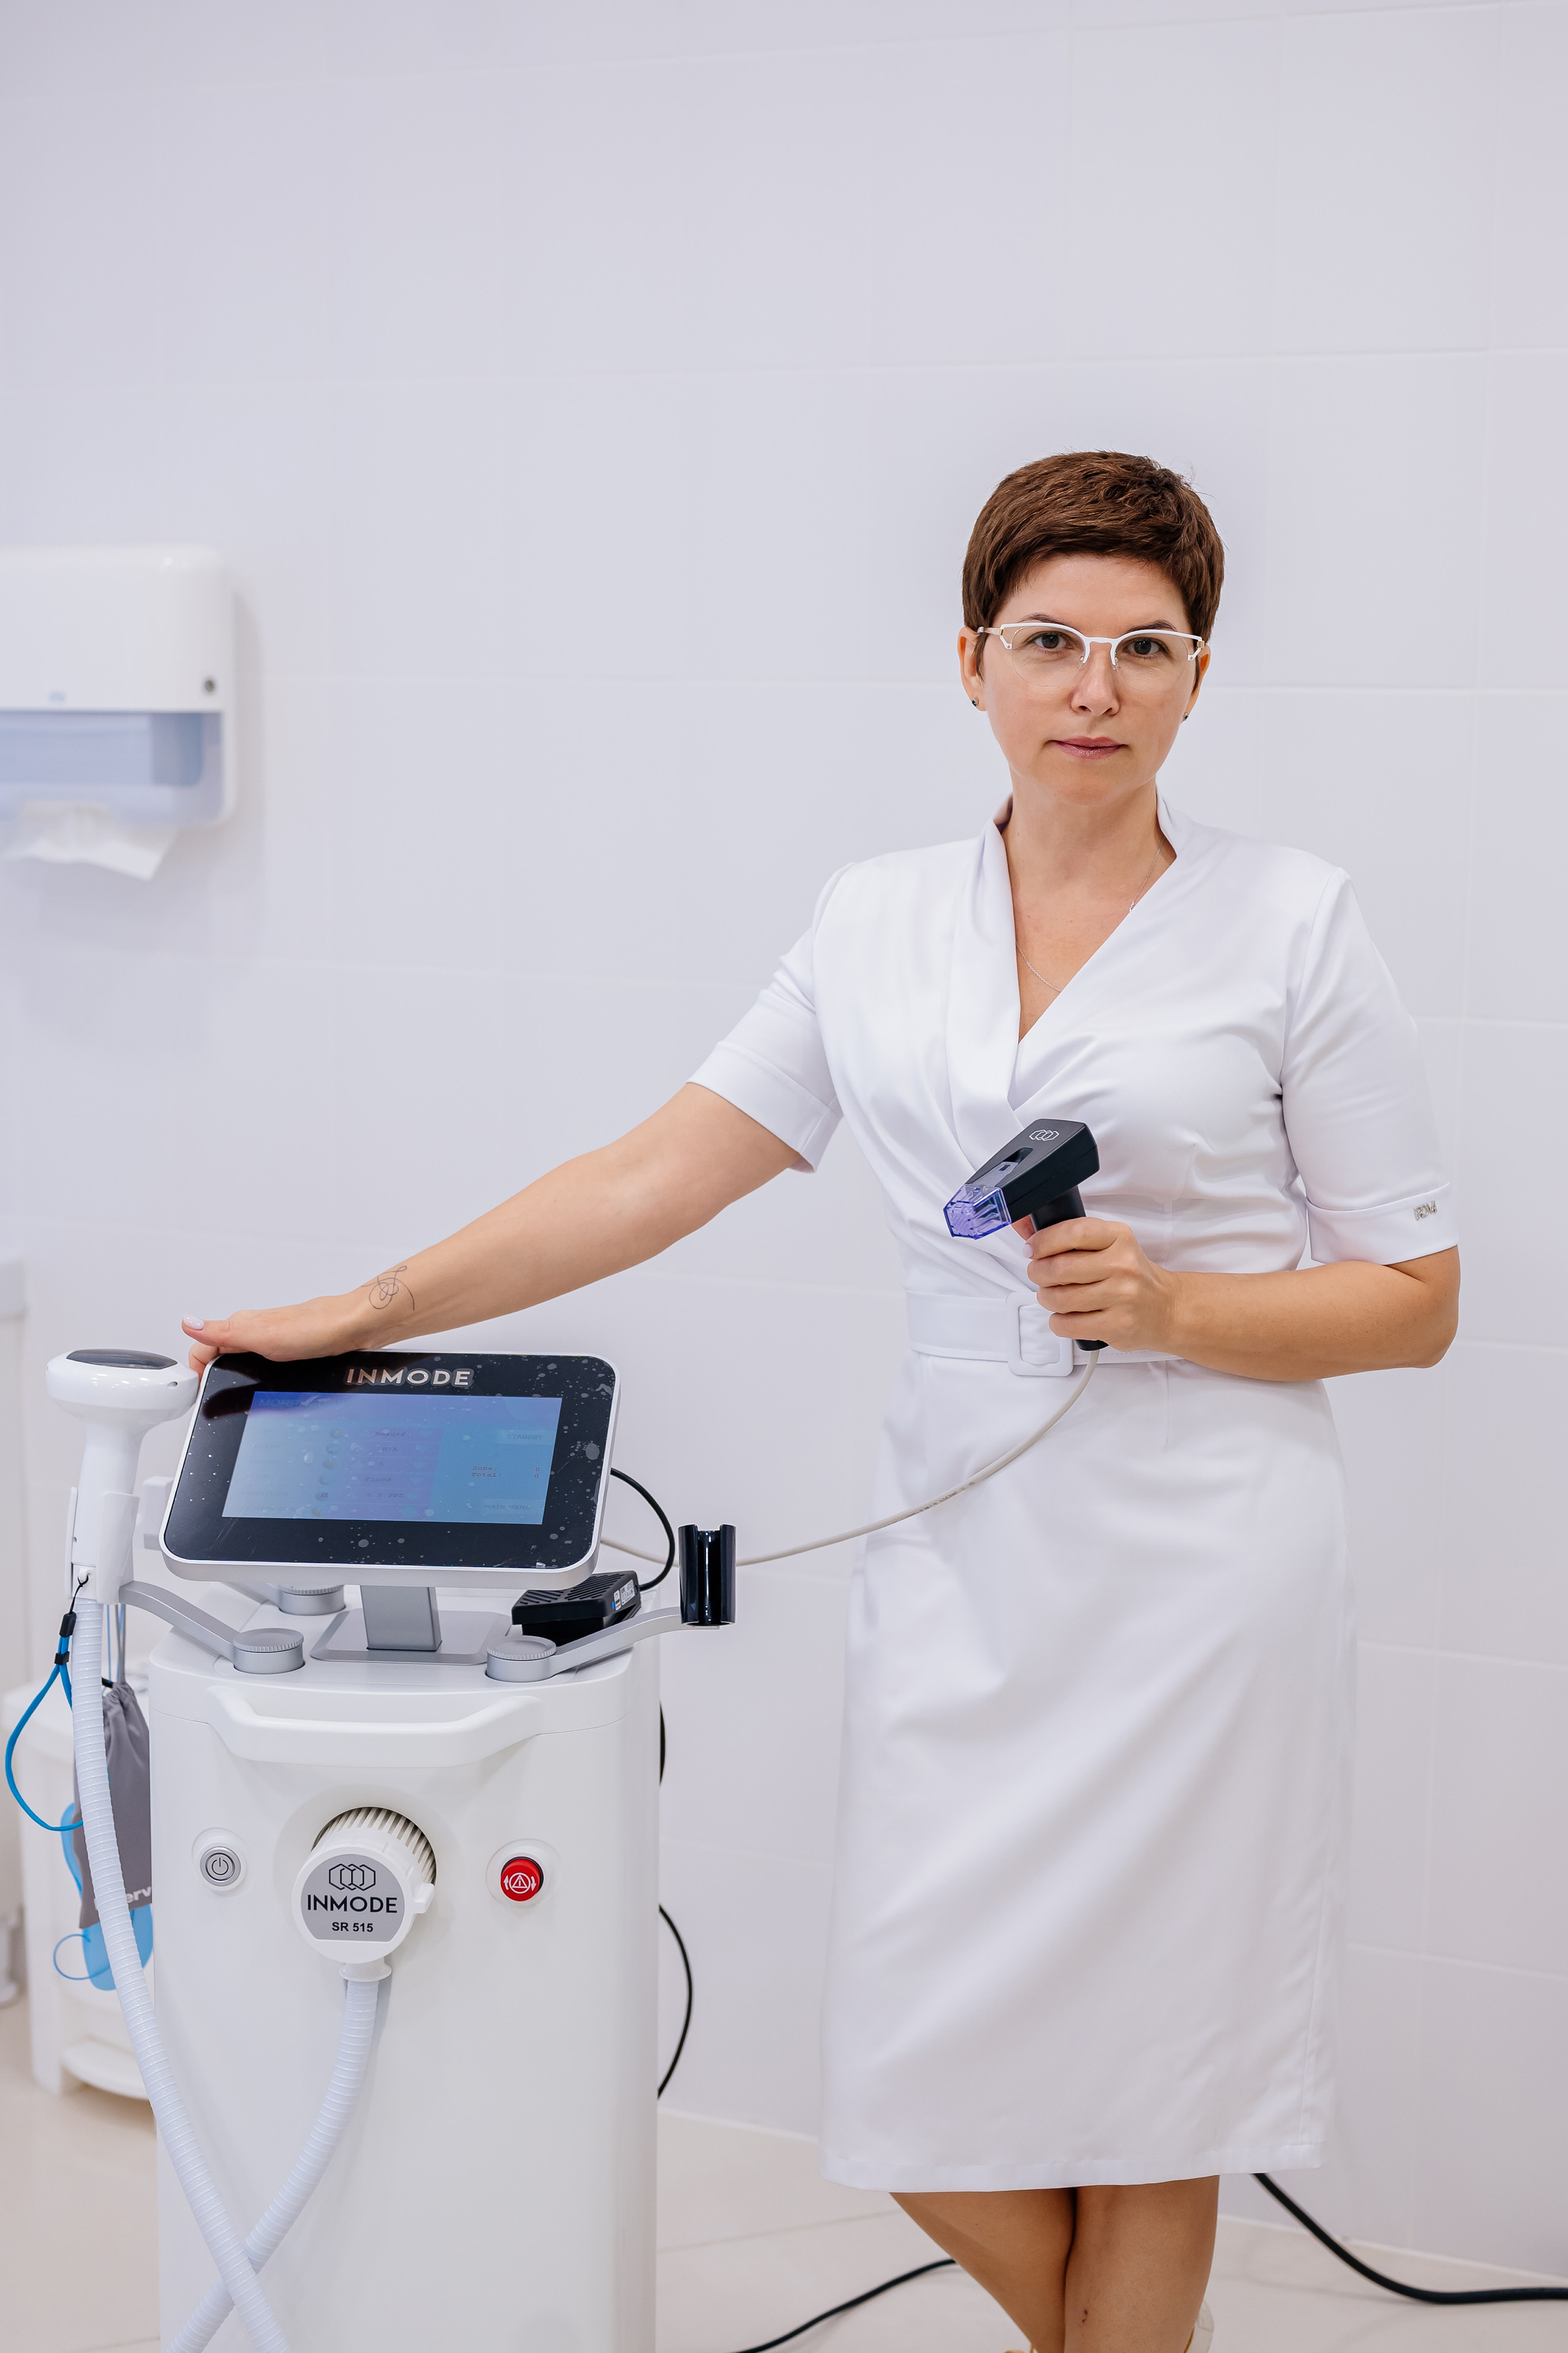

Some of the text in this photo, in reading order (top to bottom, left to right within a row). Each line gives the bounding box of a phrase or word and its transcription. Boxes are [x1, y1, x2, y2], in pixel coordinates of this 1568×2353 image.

[347, 1368, 470, 1386] INMODE
[307, 1894, 398, 1913] INMODE
[331, 1922, 374, 1932] SR 515
